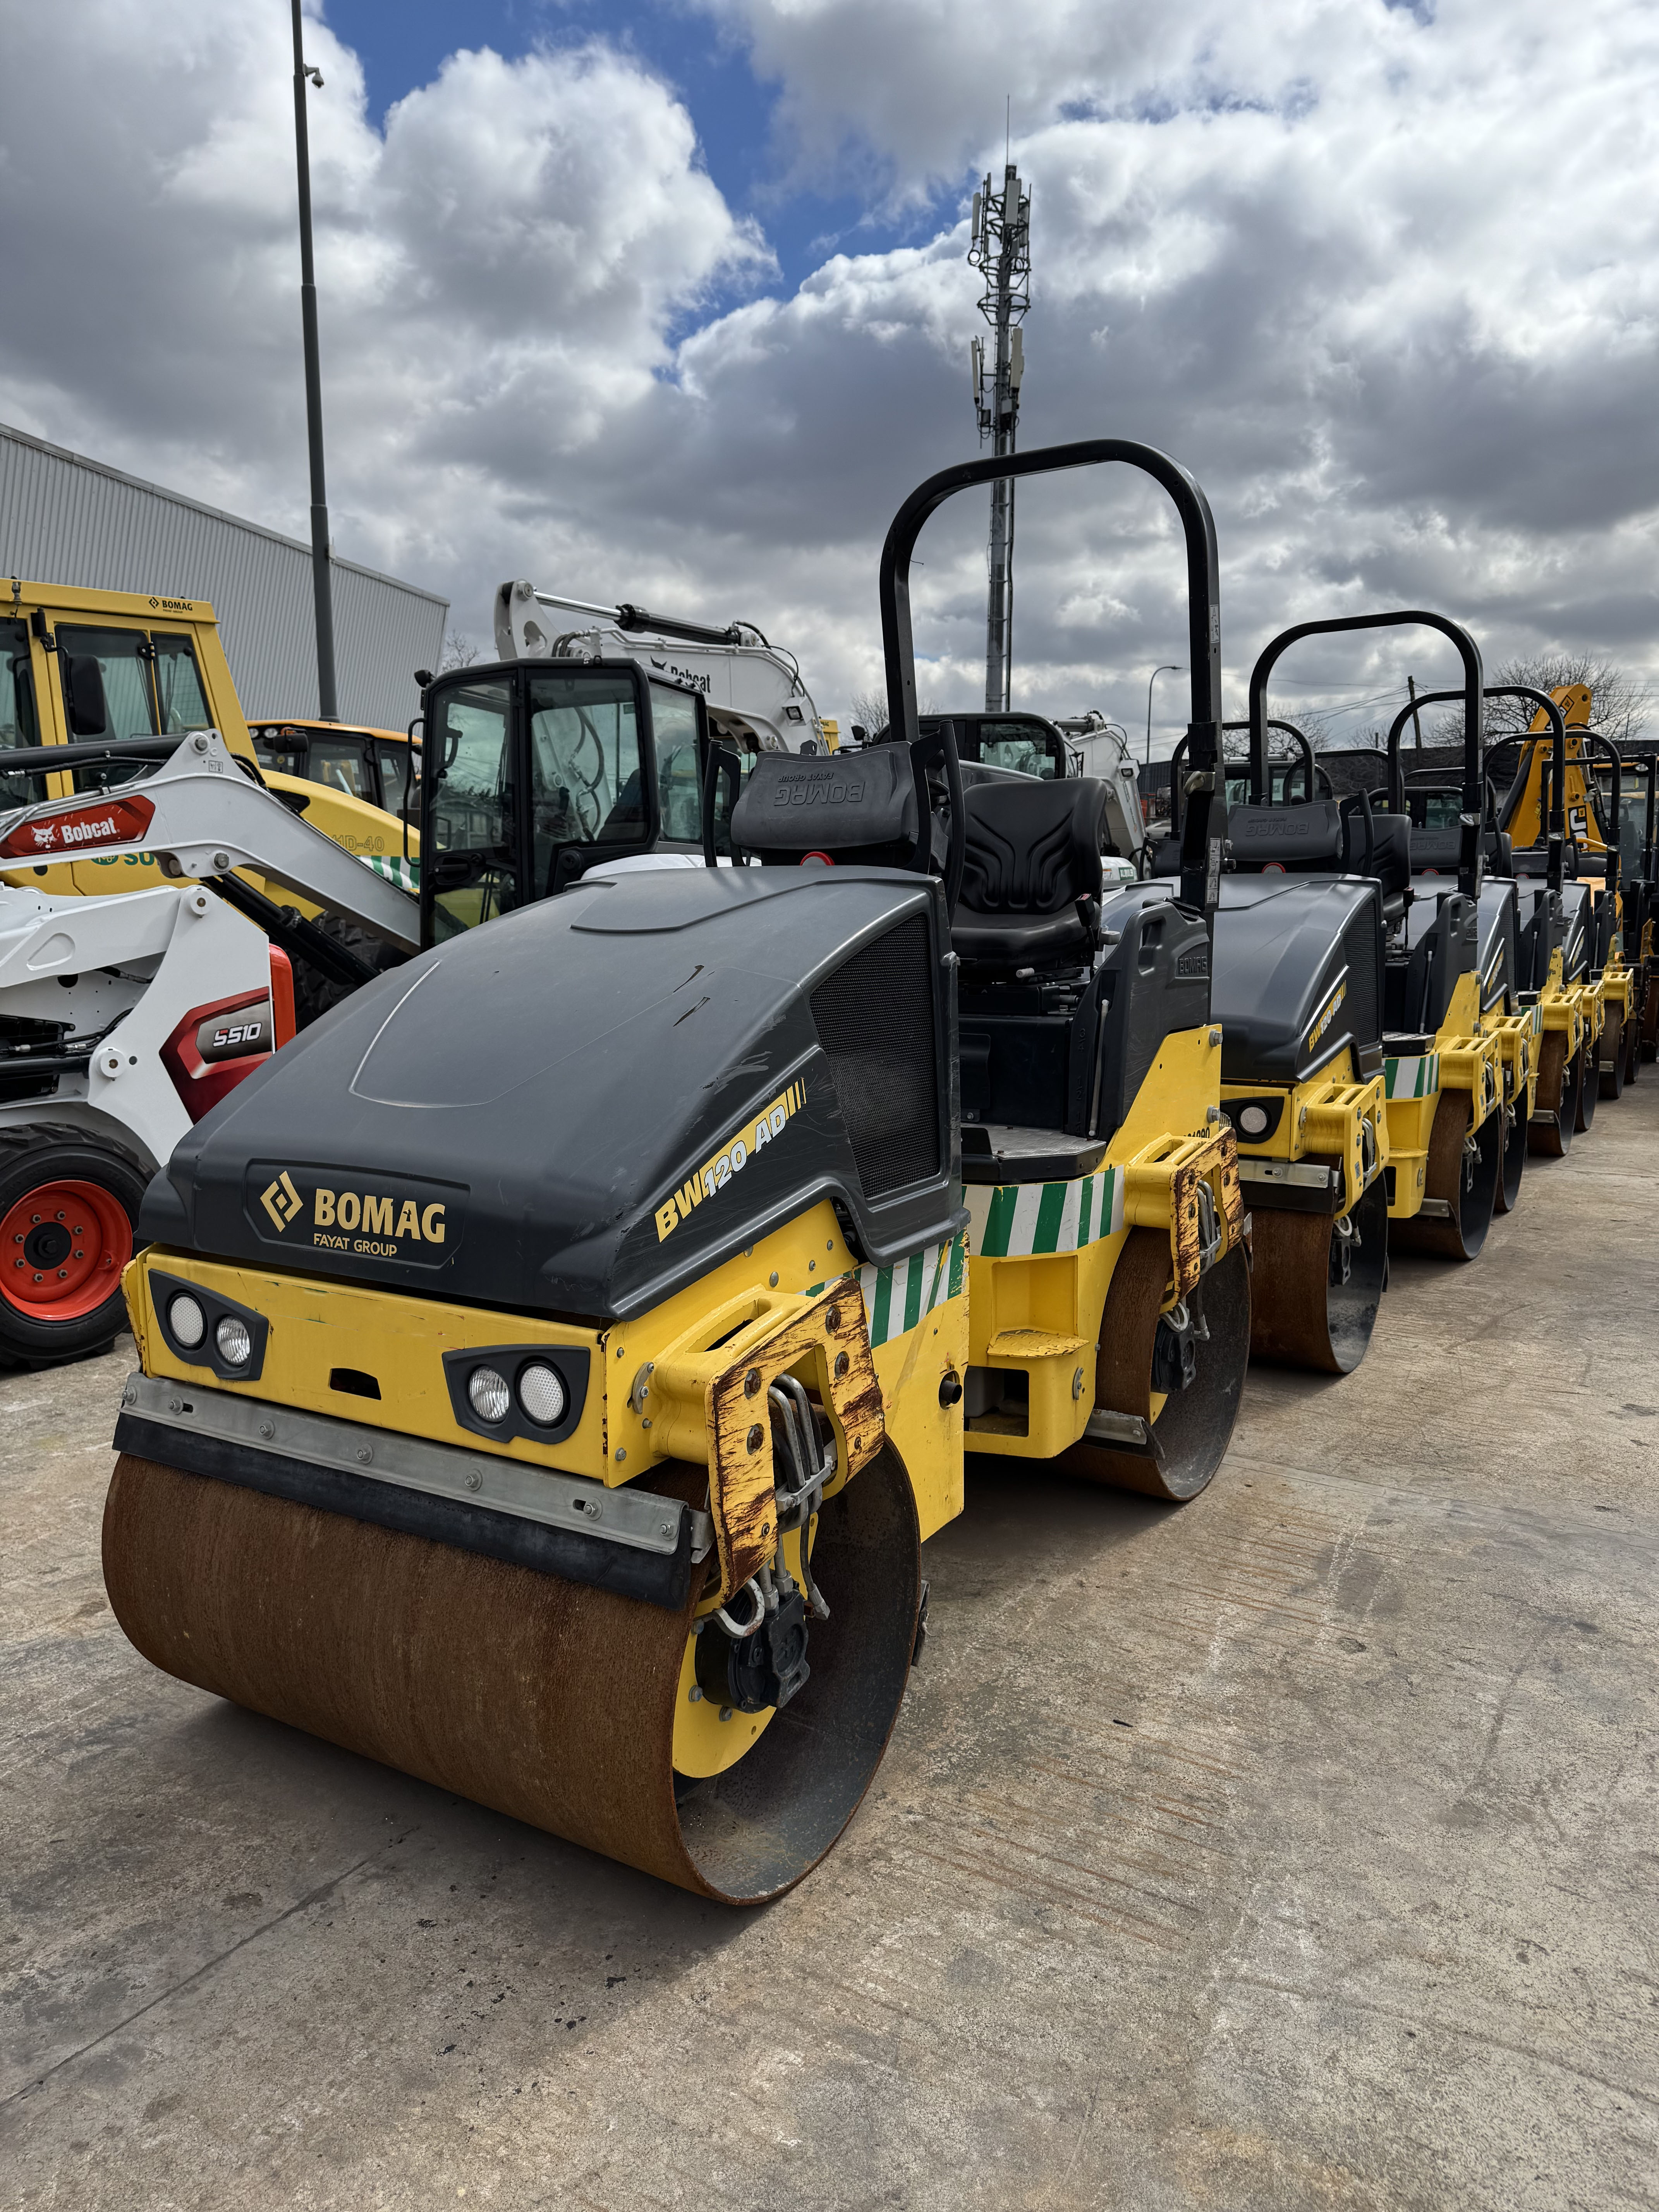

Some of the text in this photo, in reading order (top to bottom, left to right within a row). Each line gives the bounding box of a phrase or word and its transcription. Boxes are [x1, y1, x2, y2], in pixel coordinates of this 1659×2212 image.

[161, 600, 193, 611] BOMAG
[778, 773, 834, 782] FAYAT GROUP
[774, 781, 866, 806] BOMAG
[61, 817, 117, 843] Bobcat
[1245, 822, 1309, 836] BOMAG
[1178, 957, 1207, 974] BOMAG
[213, 1022, 262, 1047] S510
[314, 1188, 445, 1243] BOMAG
[314, 1233, 397, 1257] FAYAT GROUP
